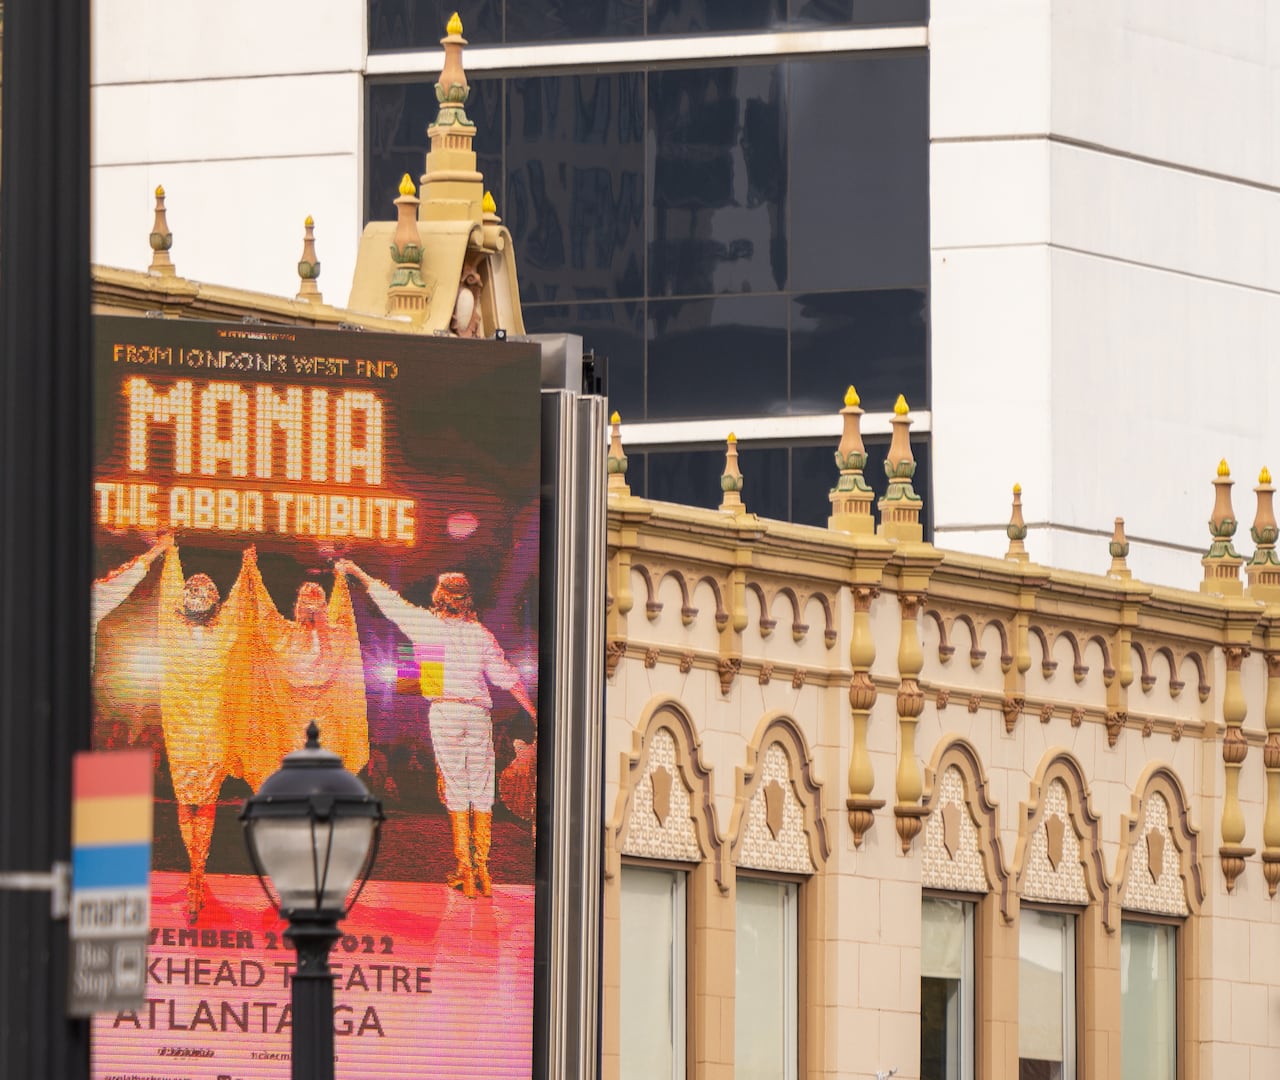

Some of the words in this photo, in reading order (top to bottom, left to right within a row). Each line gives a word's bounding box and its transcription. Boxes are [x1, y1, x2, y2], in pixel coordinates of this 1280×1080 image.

[113, 343, 172, 366] FROM
[292, 354, 350, 377] WEST
[355, 358, 399, 379] END
[129, 377, 383, 486] MANIA
[95, 482, 158, 526] THE
[170, 486, 264, 533] ABBA
[272, 491, 416, 541] TRIBUTE
[79, 893, 144, 927] marta
[148, 926, 255, 950] VEMBER
[333, 934, 394, 954] 022
[144, 957, 266, 988] KHEAD
[274, 961, 433, 994] TEATRE
[334, 1004, 385, 1038] GA
